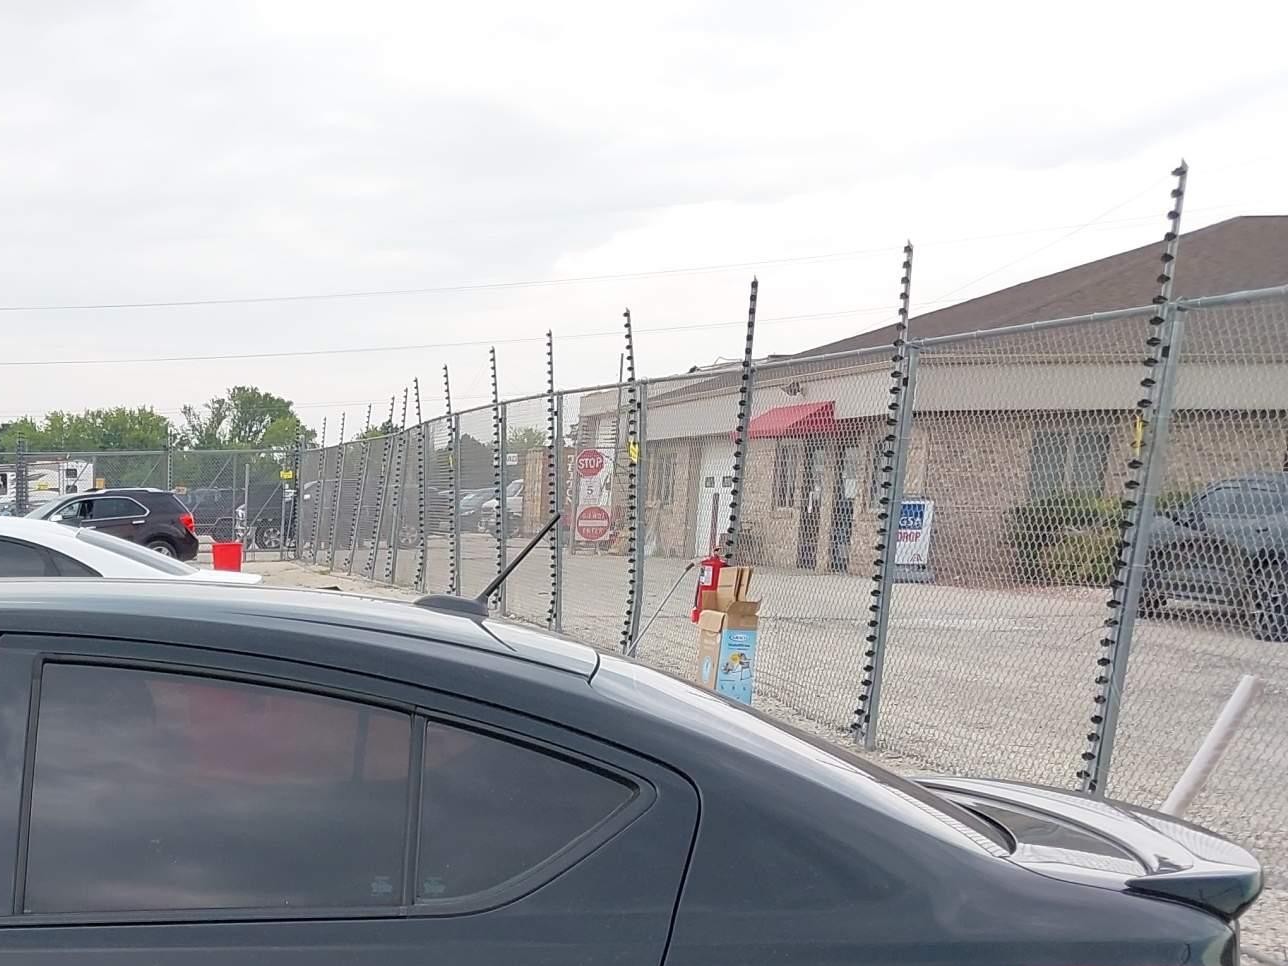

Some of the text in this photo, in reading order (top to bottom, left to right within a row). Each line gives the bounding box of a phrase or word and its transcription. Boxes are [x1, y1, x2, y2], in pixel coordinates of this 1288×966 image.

[578, 457, 603, 469] STOP
[587, 485, 594, 495] 5
[897, 531, 921, 542] DROP
